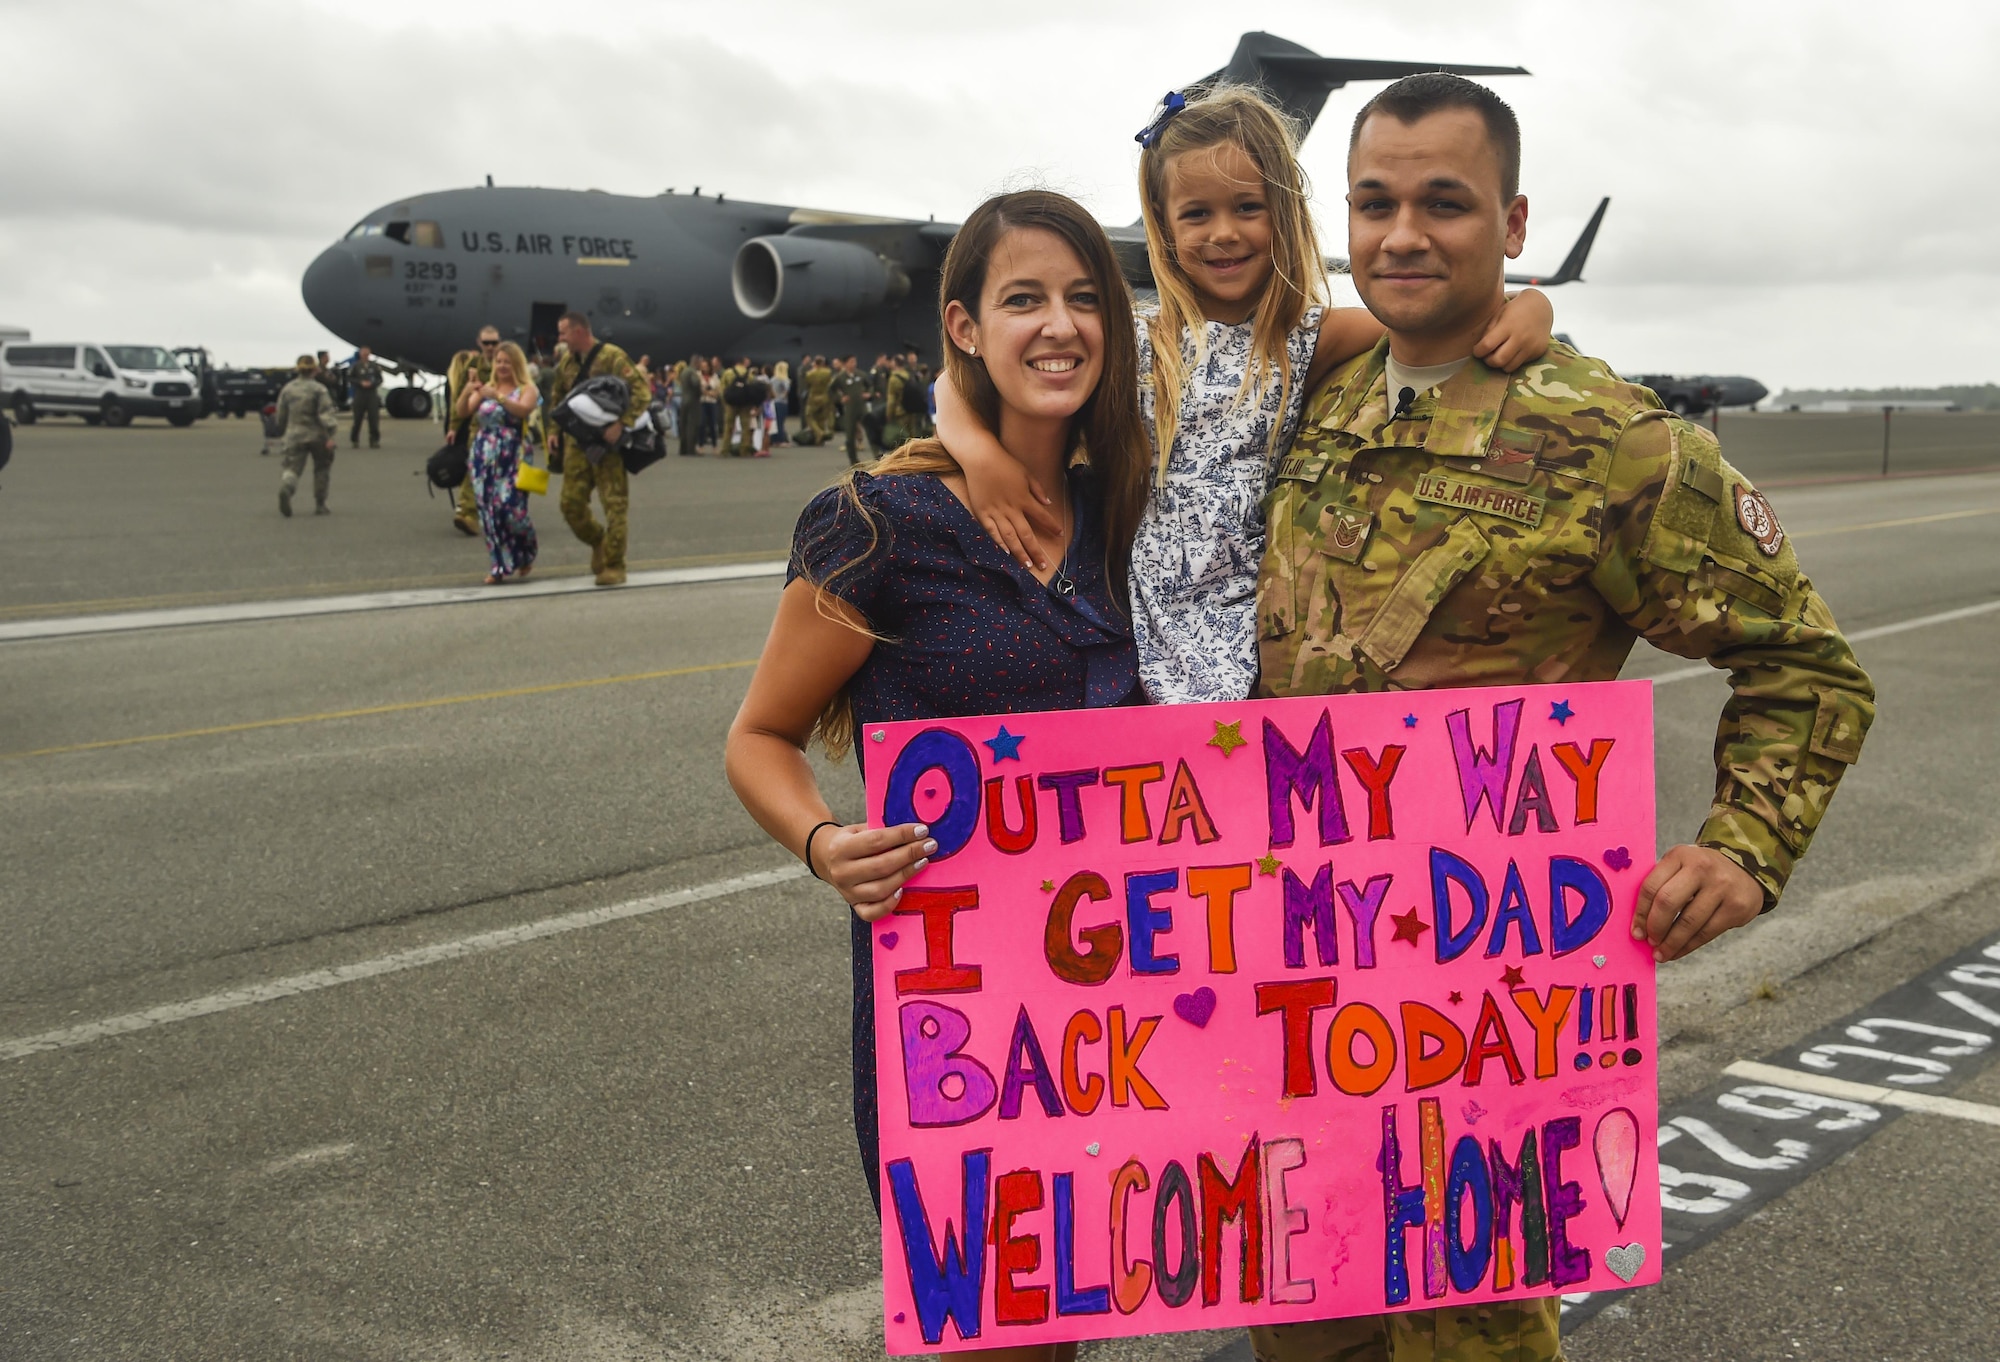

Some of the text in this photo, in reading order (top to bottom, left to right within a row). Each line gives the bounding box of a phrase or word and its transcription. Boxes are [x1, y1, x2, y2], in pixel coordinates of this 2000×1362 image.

[404, 261, 457, 281] 3293
[462, 231, 639, 260] U.S. AIR FORCE
[1419, 478, 1540, 522] U.S. AIR FORCE
[883, 697, 1616, 862] OUTTA MY WAY
[892, 846, 1613, 994] I GET MY DAD
[899, 976, 1642, 1128] BACK TODAY!!!
[886, 1097, 1640, 1345] WELCOME HOME!
